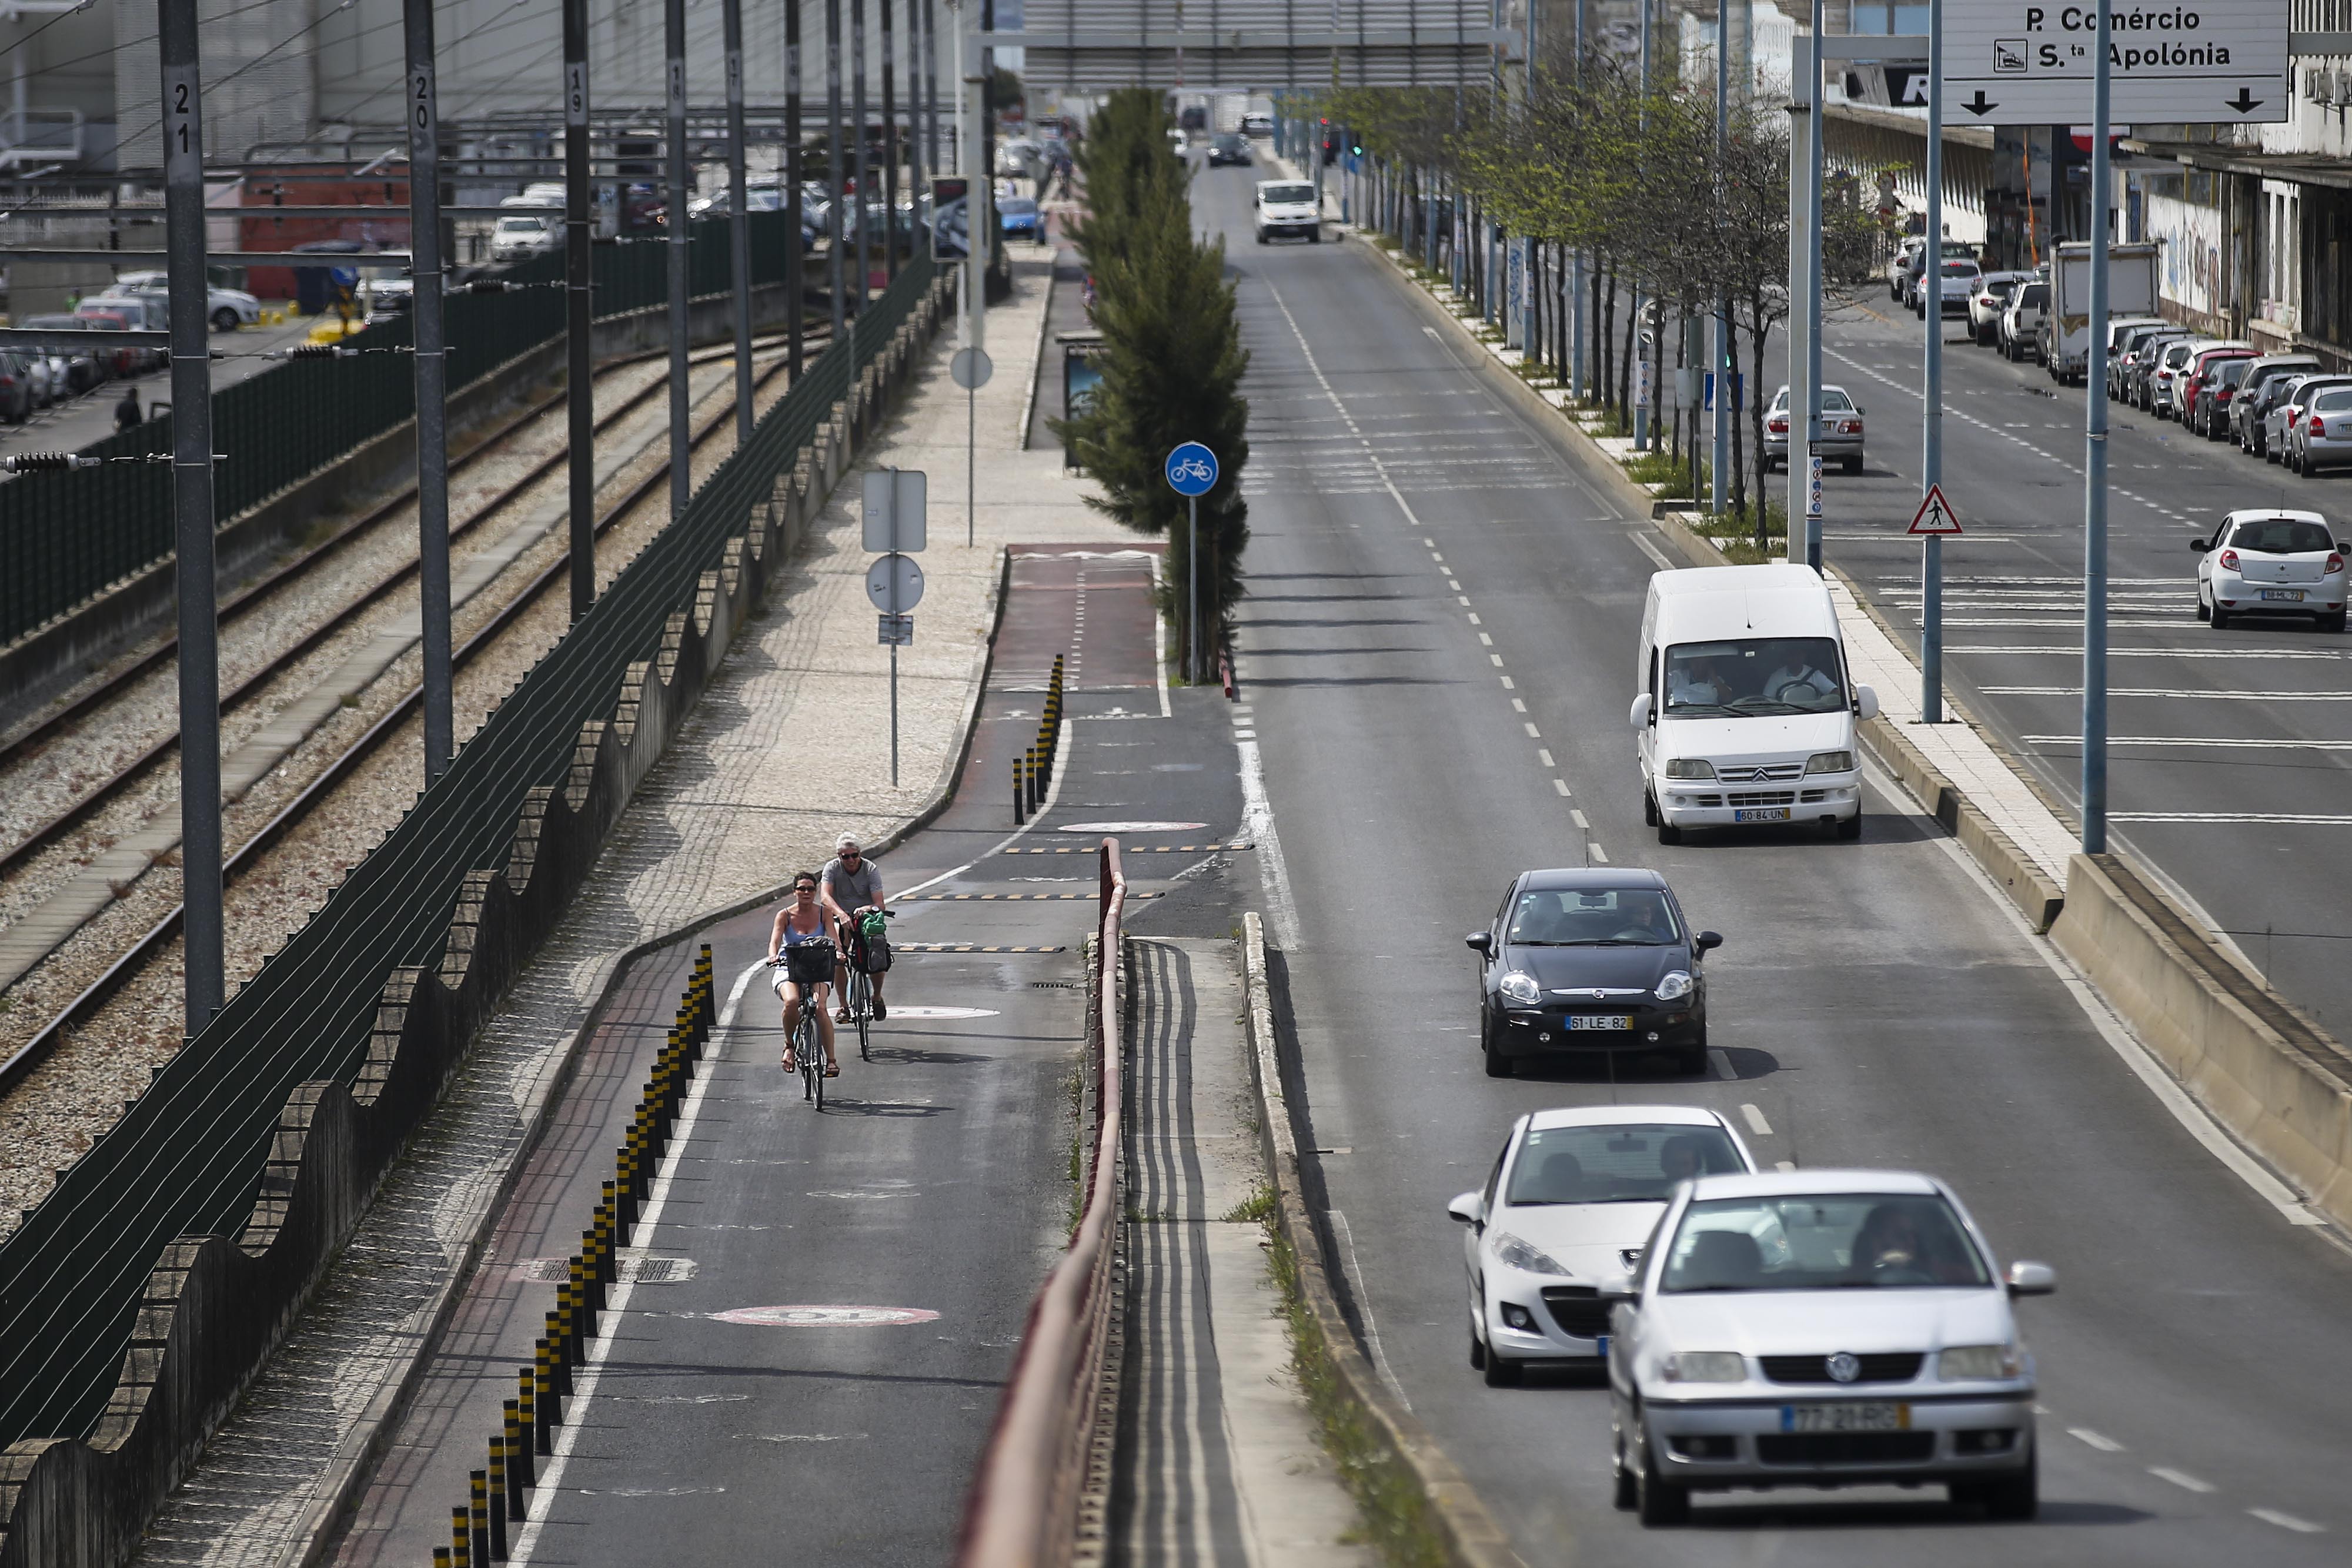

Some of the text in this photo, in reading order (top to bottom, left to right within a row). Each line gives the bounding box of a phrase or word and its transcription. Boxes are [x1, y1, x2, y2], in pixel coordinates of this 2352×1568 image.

[2026, 6, 2200, 32] P. Comércio
[2109, 42, 2231, 71] Apolónia
[416, 76, 427, 129] 20
[572, 69, 582, 112] 19
[175, 83, 189, 153] 21
